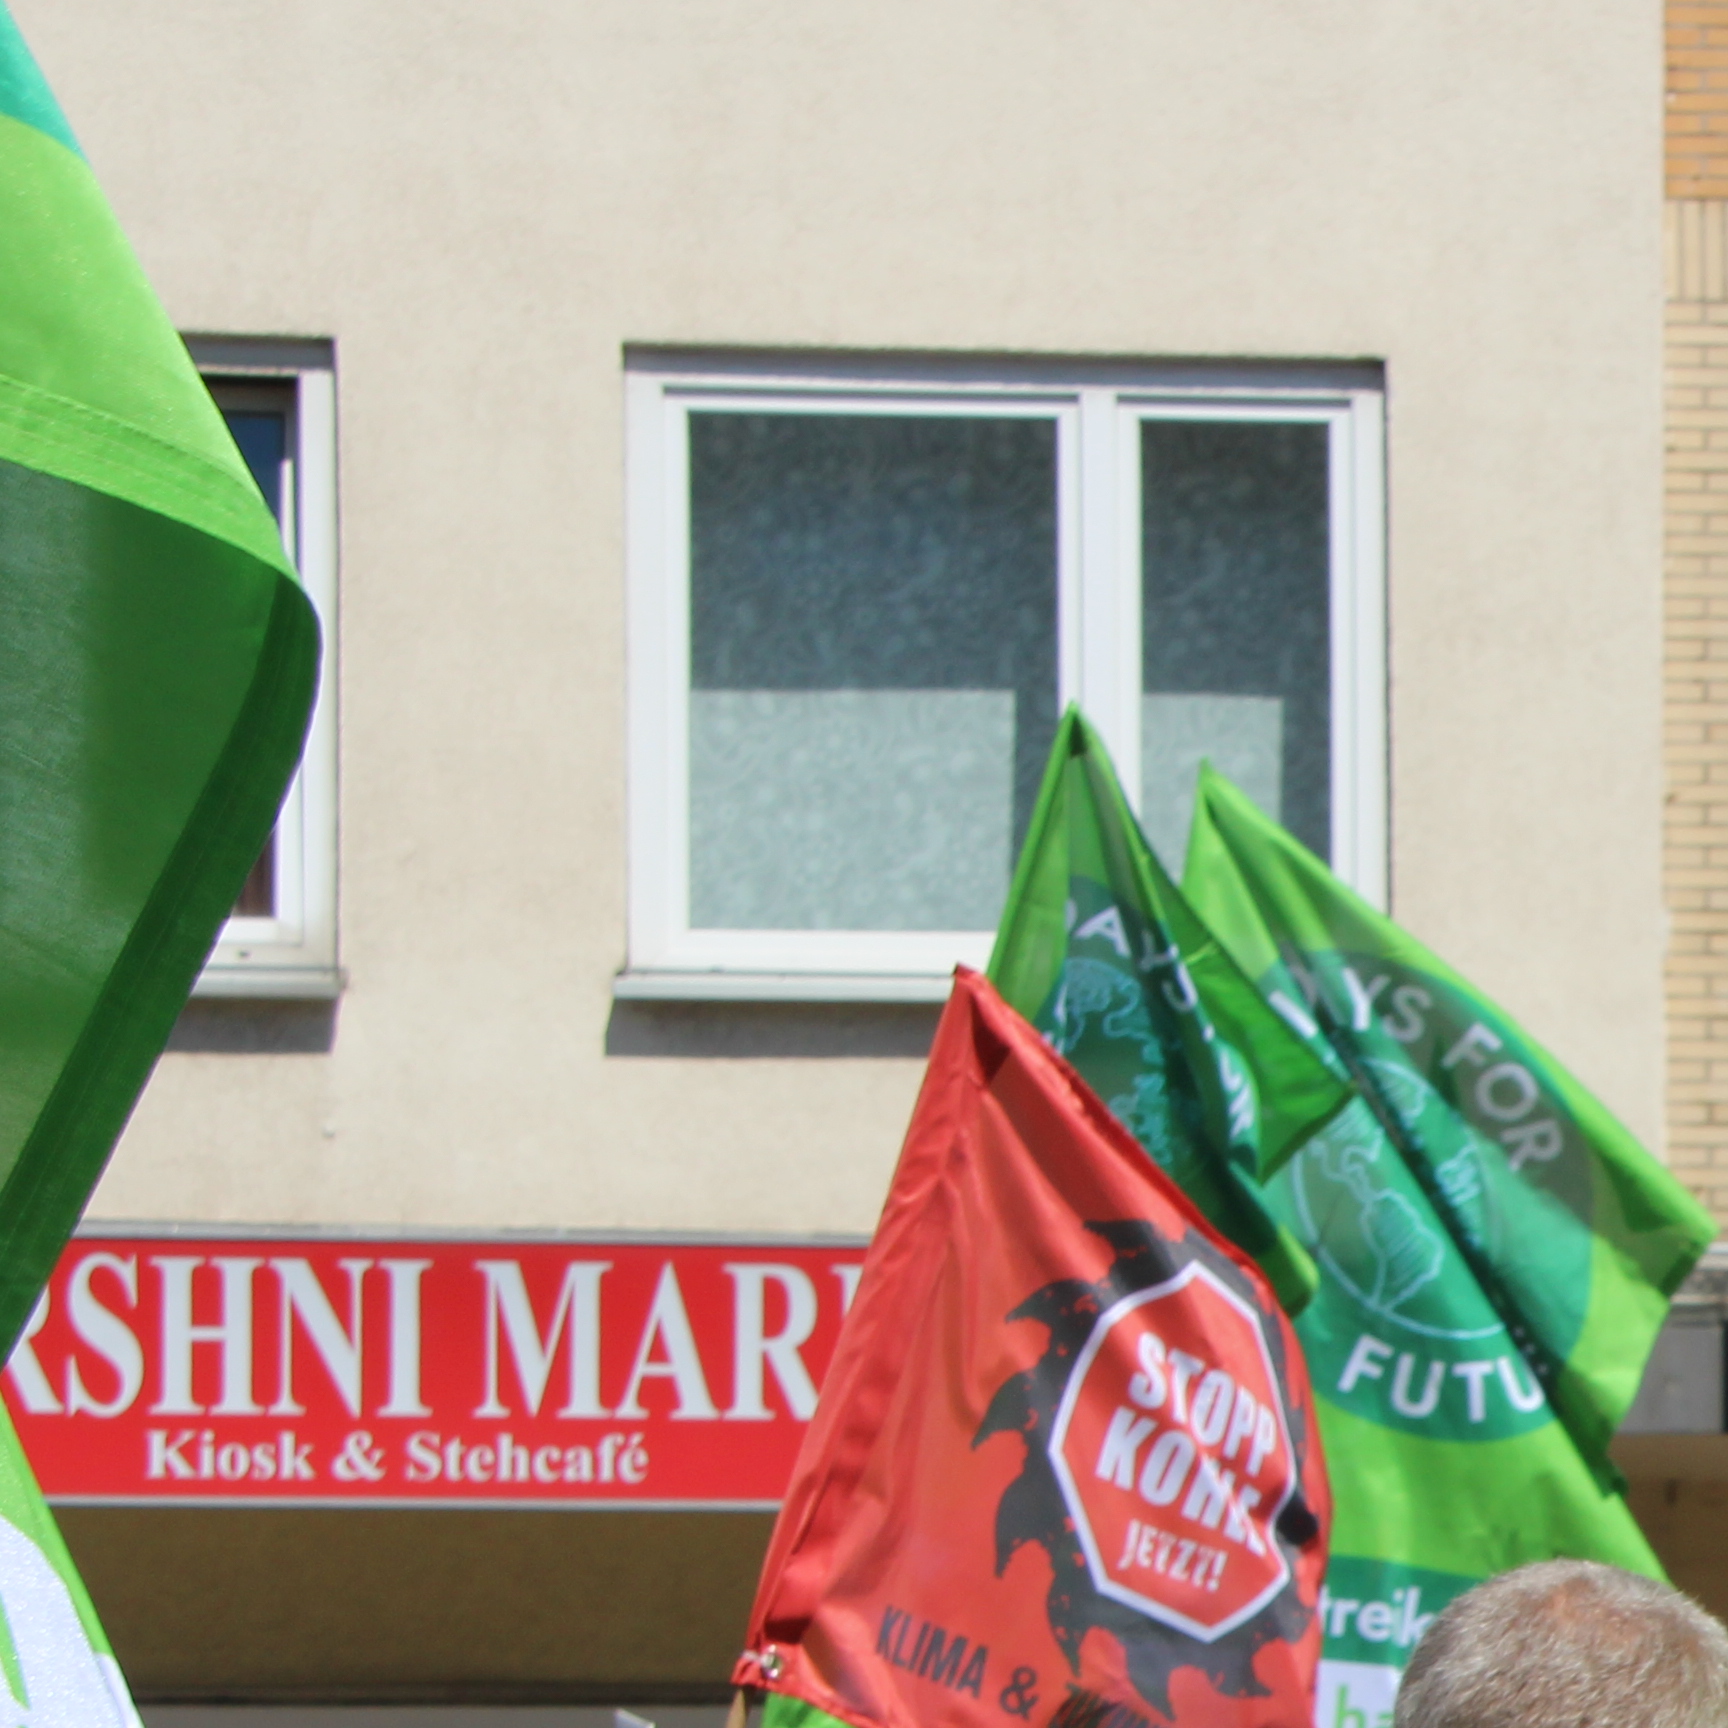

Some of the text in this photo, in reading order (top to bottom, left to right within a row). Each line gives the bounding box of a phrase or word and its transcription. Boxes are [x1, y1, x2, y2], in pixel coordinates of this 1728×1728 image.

[1443, 1023, 1566, 1174] FOR
[475, 1257, 864, 1421] MAR
[1337, 1334, 1548, 1423] FUTU
[145, 1428, 650, 1484] Kiosk & Stehcafé
[1129, 1330, 1278, 1477] STOPP
[1117, 1519, 1230, 1593] JETZT!
[875, 1604, 990, 1707] KLIMA
[998, 1666, 1041, 1721] &
